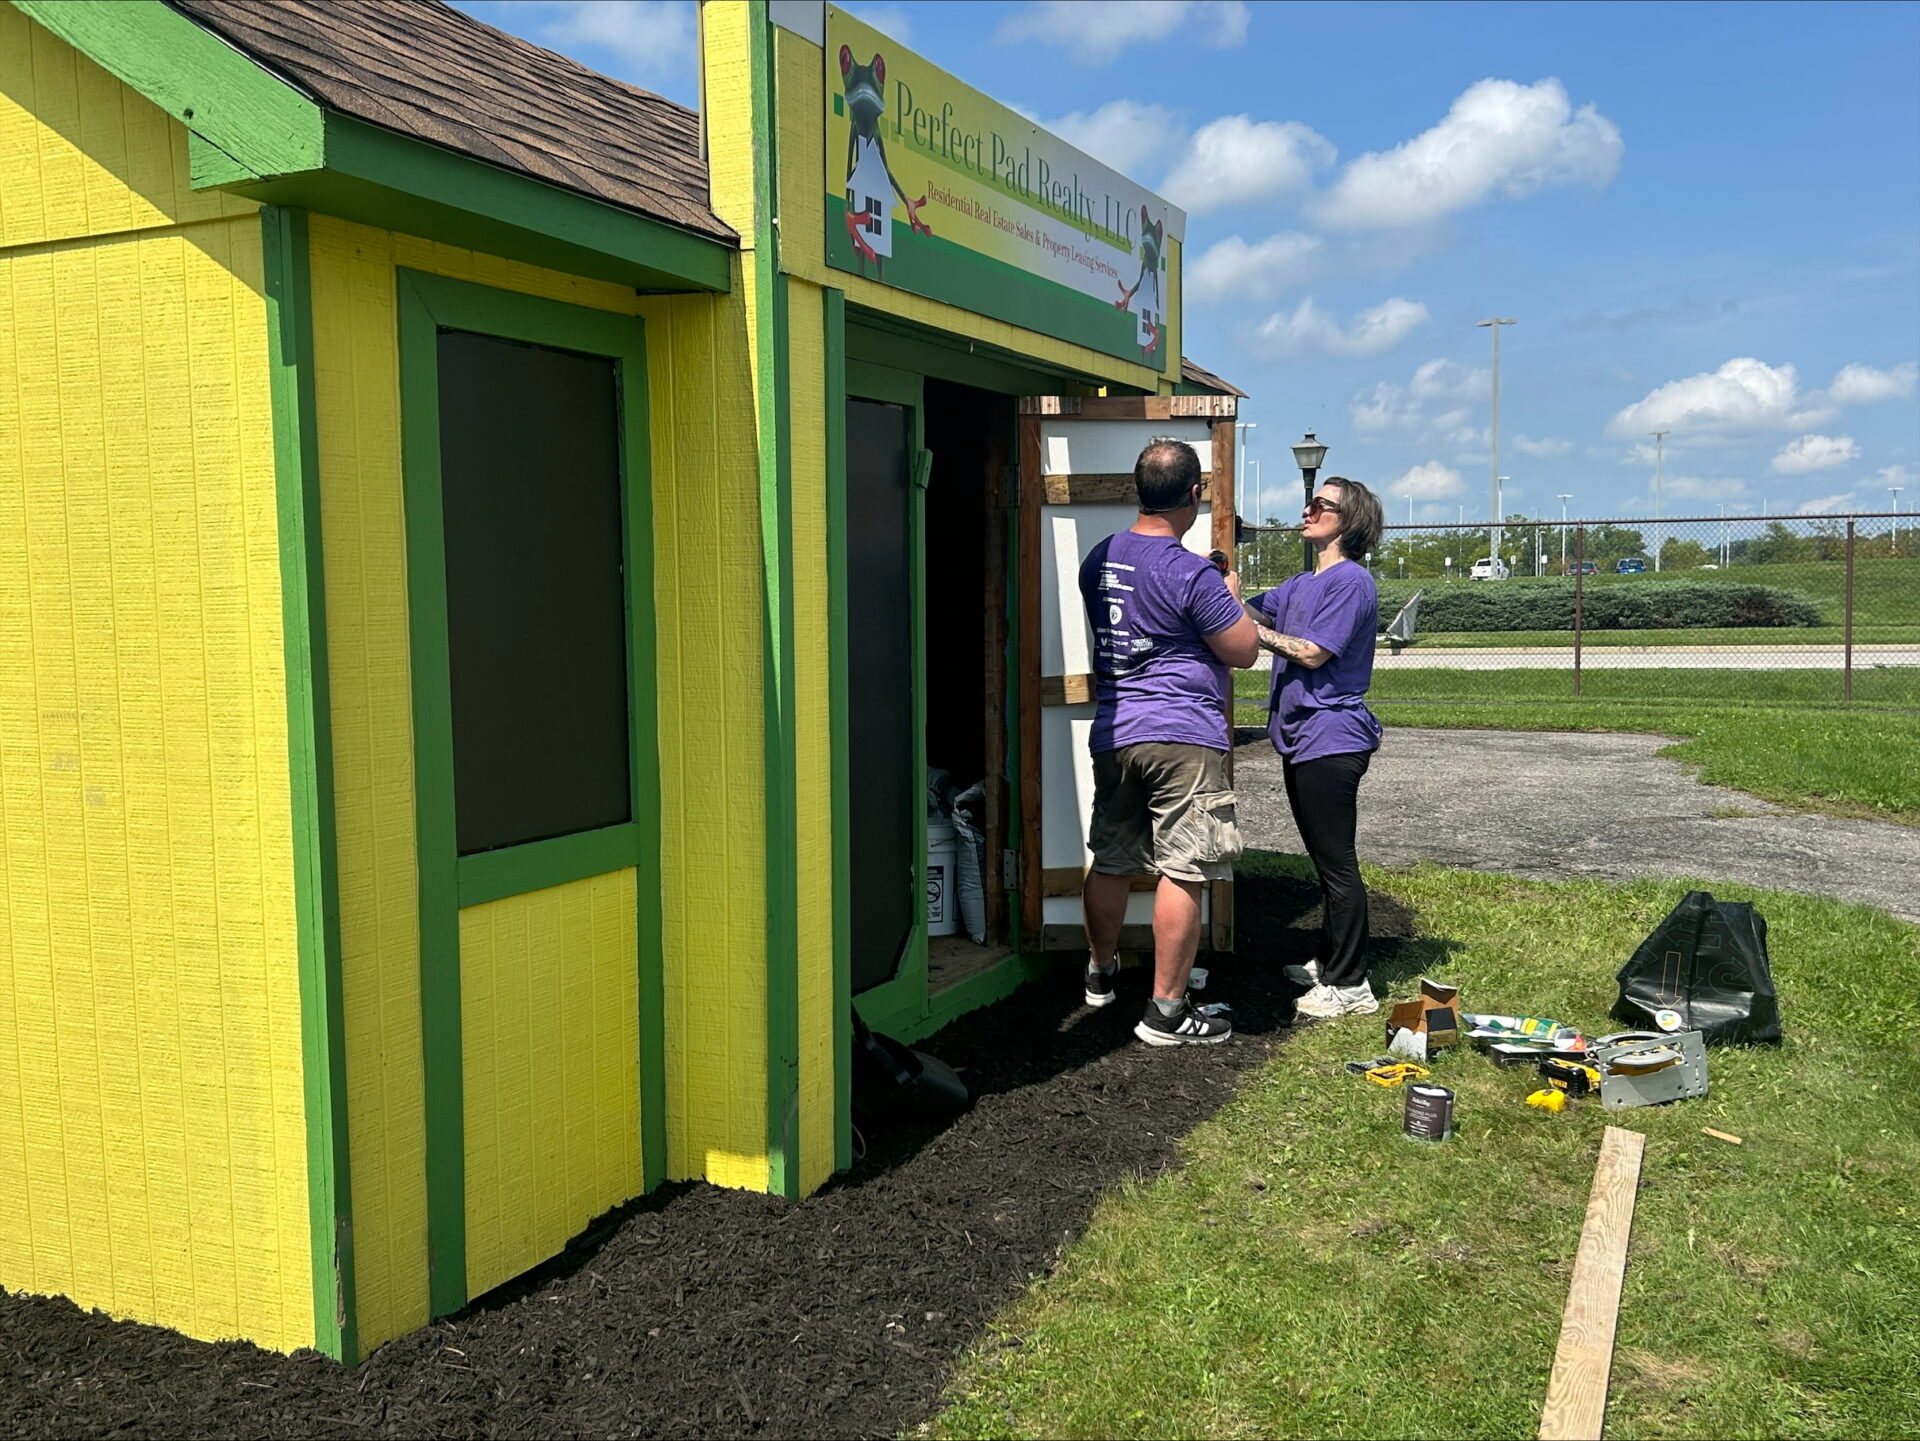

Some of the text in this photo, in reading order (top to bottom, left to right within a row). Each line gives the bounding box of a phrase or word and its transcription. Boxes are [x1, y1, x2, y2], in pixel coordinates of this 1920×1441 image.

[894, 78, 1137, 250] Perfect Pad Realty, LLC
[927, 179, 1118, 278] Residential Real Estate Sales & Property Leasing Services
